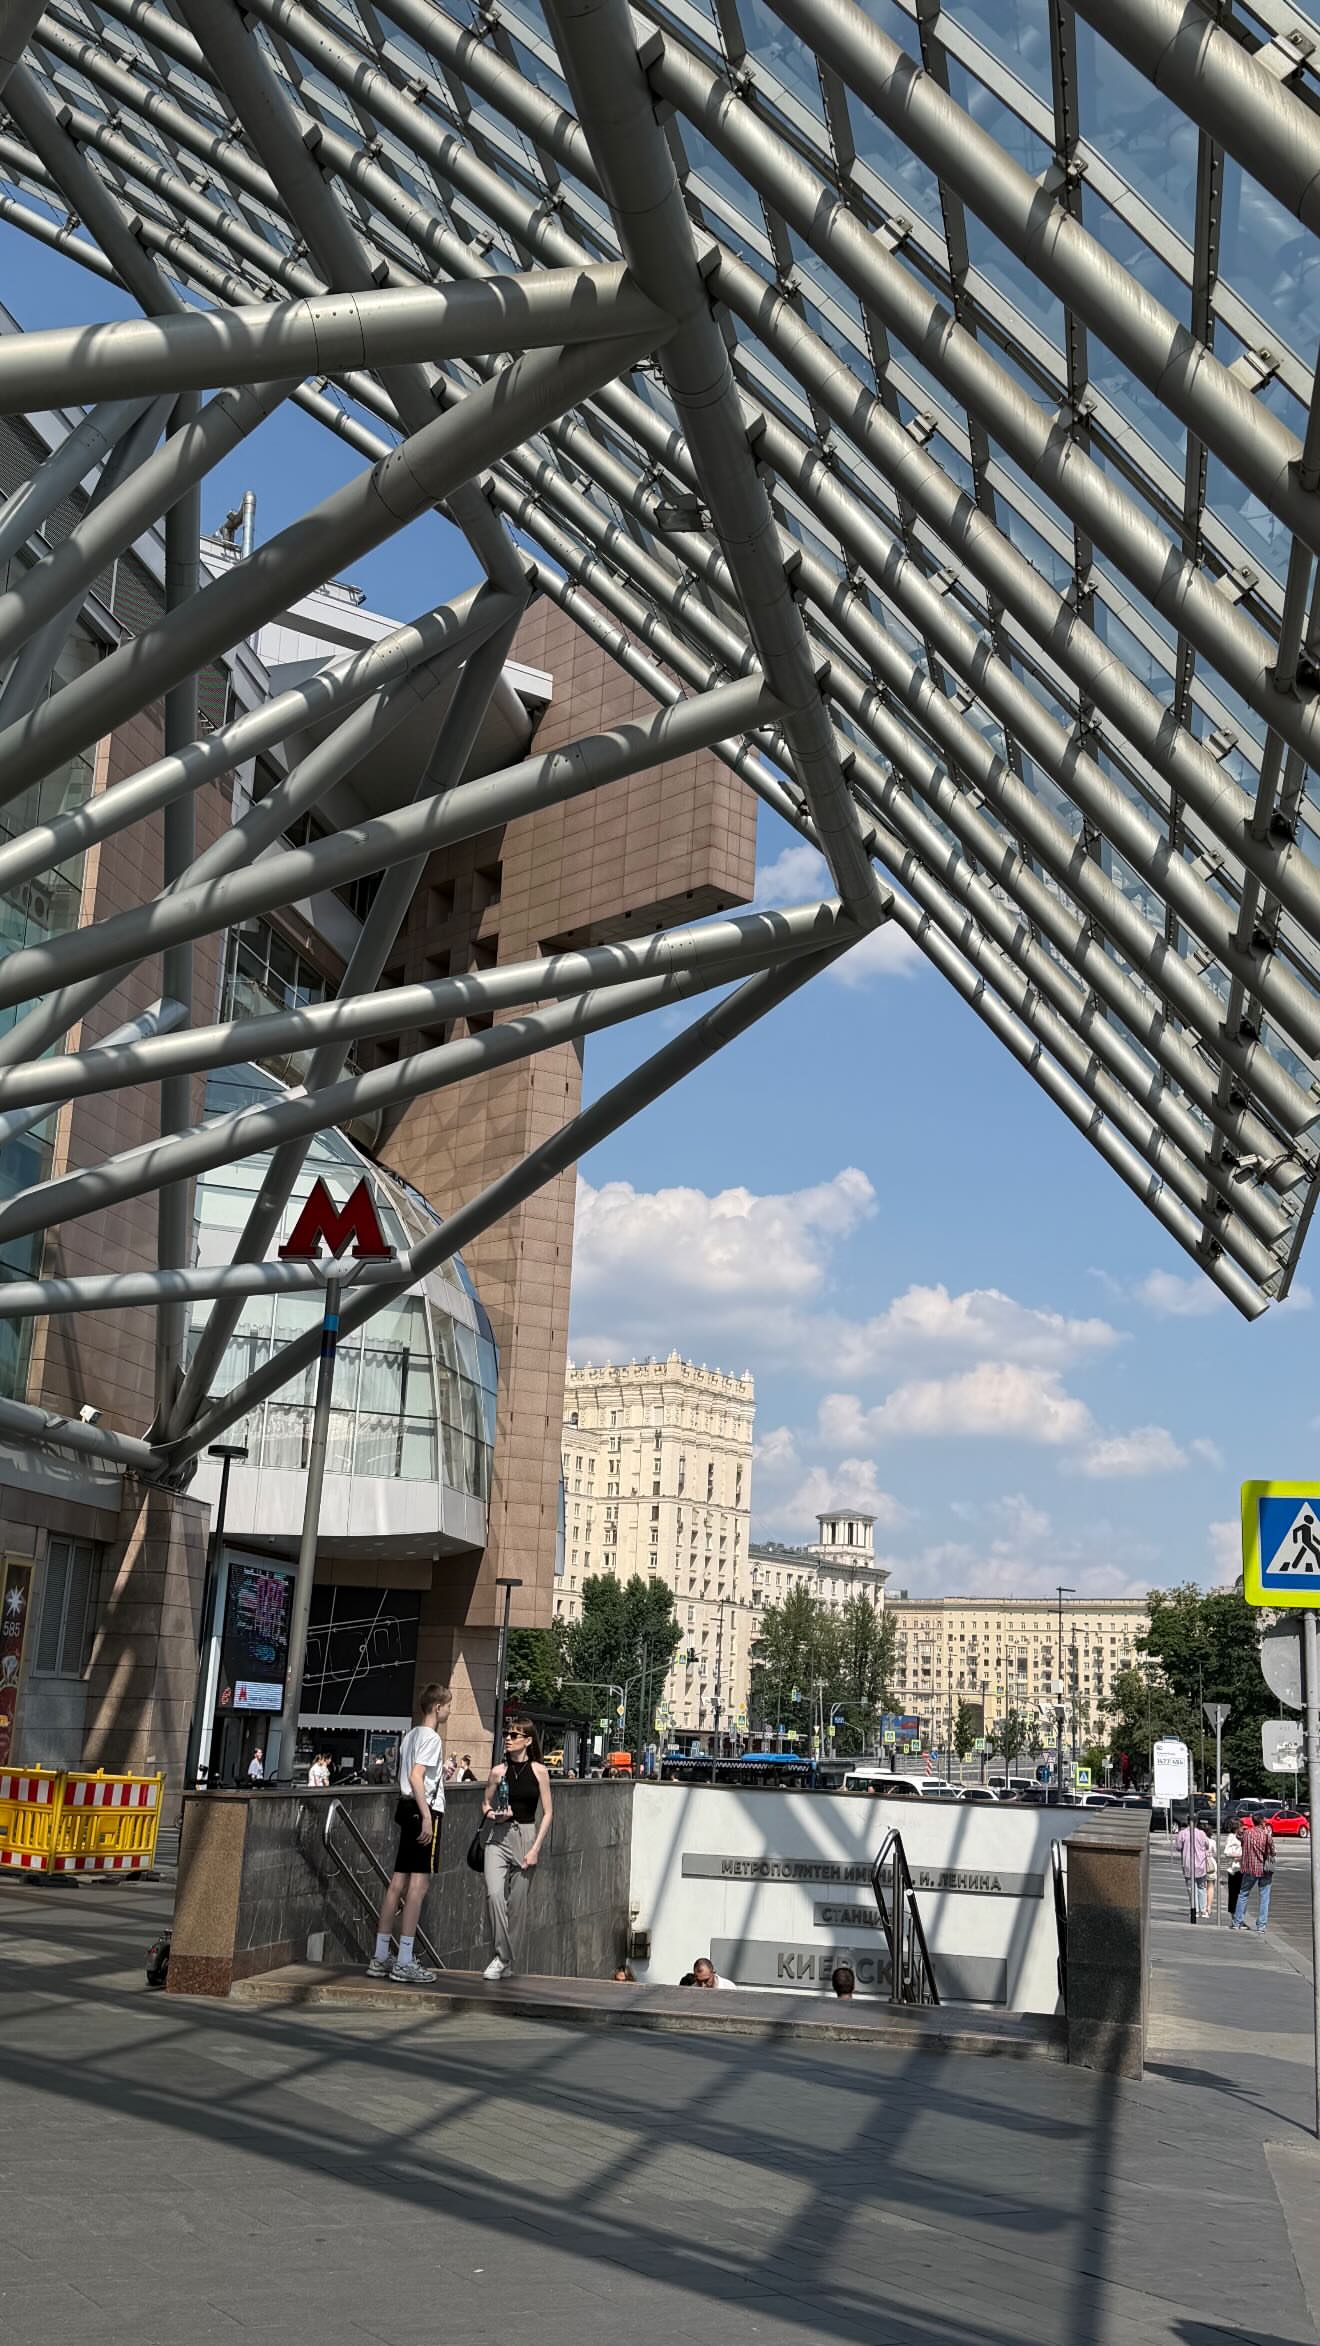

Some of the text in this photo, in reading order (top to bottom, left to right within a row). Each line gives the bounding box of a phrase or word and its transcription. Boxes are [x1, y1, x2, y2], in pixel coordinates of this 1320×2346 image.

[3, 1621, 21, 1638] 585
[721, 1859, 840, 1880] МЕТРОПОЛИТЕН
[937, 1872, 1002, 1891] ЛЕНИНА
[822, 1907, 894, 1925] СТАНЦИ
